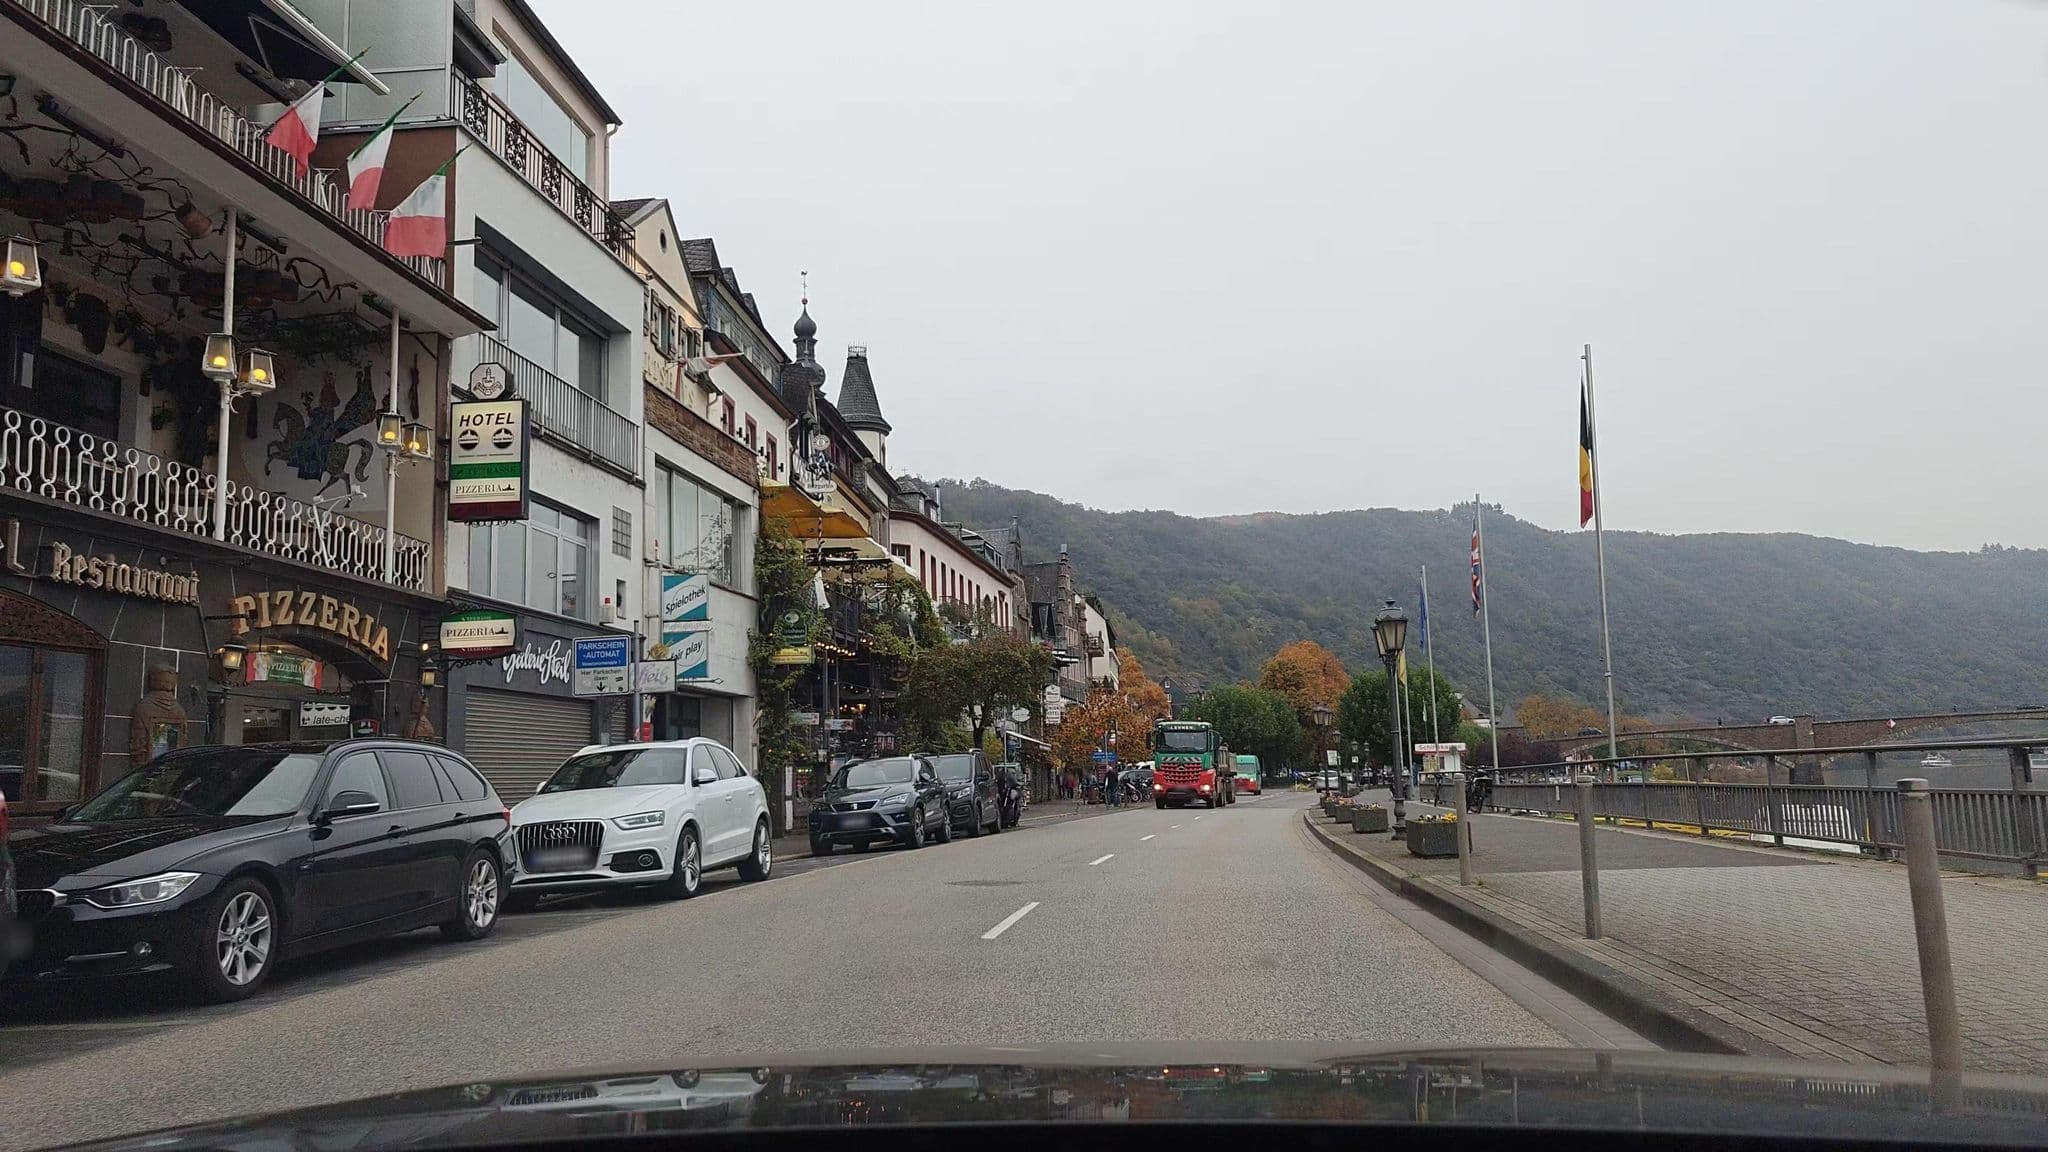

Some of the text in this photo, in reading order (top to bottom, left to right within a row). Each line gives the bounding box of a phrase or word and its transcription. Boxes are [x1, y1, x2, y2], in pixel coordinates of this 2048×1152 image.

[459, 413, 515, 427] HOTEL
[455, 484, 502, 494] PIZZERIA
[665, 584, 706, 616] Spielothek
[234, 590, 389, 662] PIZZERIA
[446, 626, 495, 637] PIZZERIA
[578, 641, 625, 651] PARKSCHEIN
[685, 640, 704, 659] play
